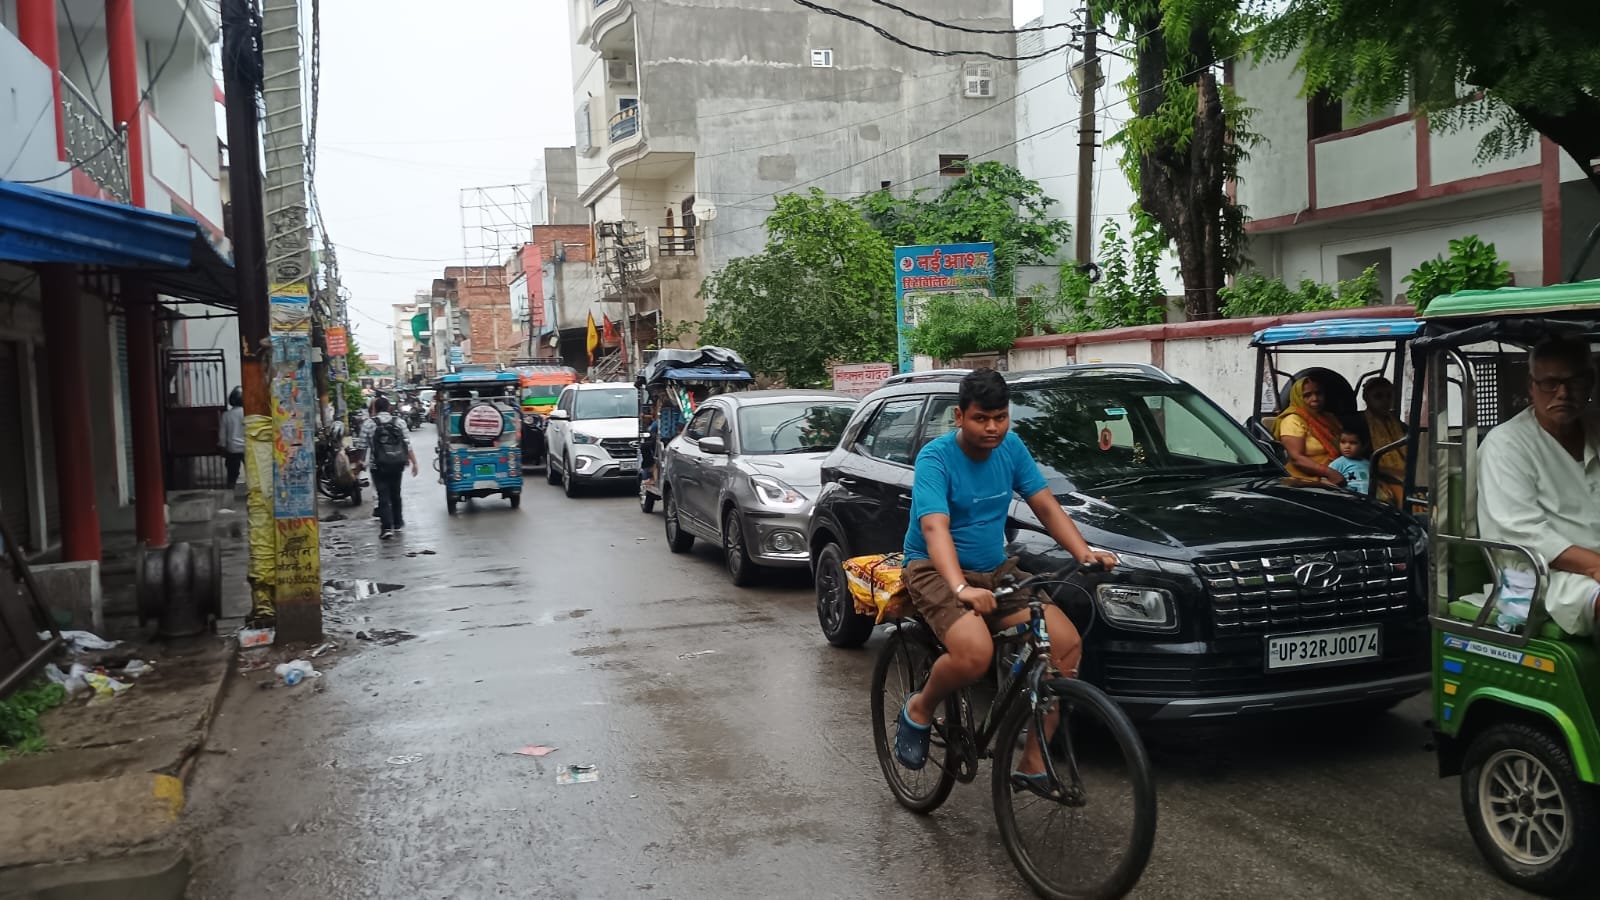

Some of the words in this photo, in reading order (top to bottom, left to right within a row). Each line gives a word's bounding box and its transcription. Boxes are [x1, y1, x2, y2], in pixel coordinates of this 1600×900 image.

[916, 248, 942, 273] नई
[864, 368, 890, 380] यादव
[1279, 633, 1377, 661] UP32RJ0074
[1469, 643, 1488, 654] INDO
[1490, 648, 1518, 661] WAGEN
